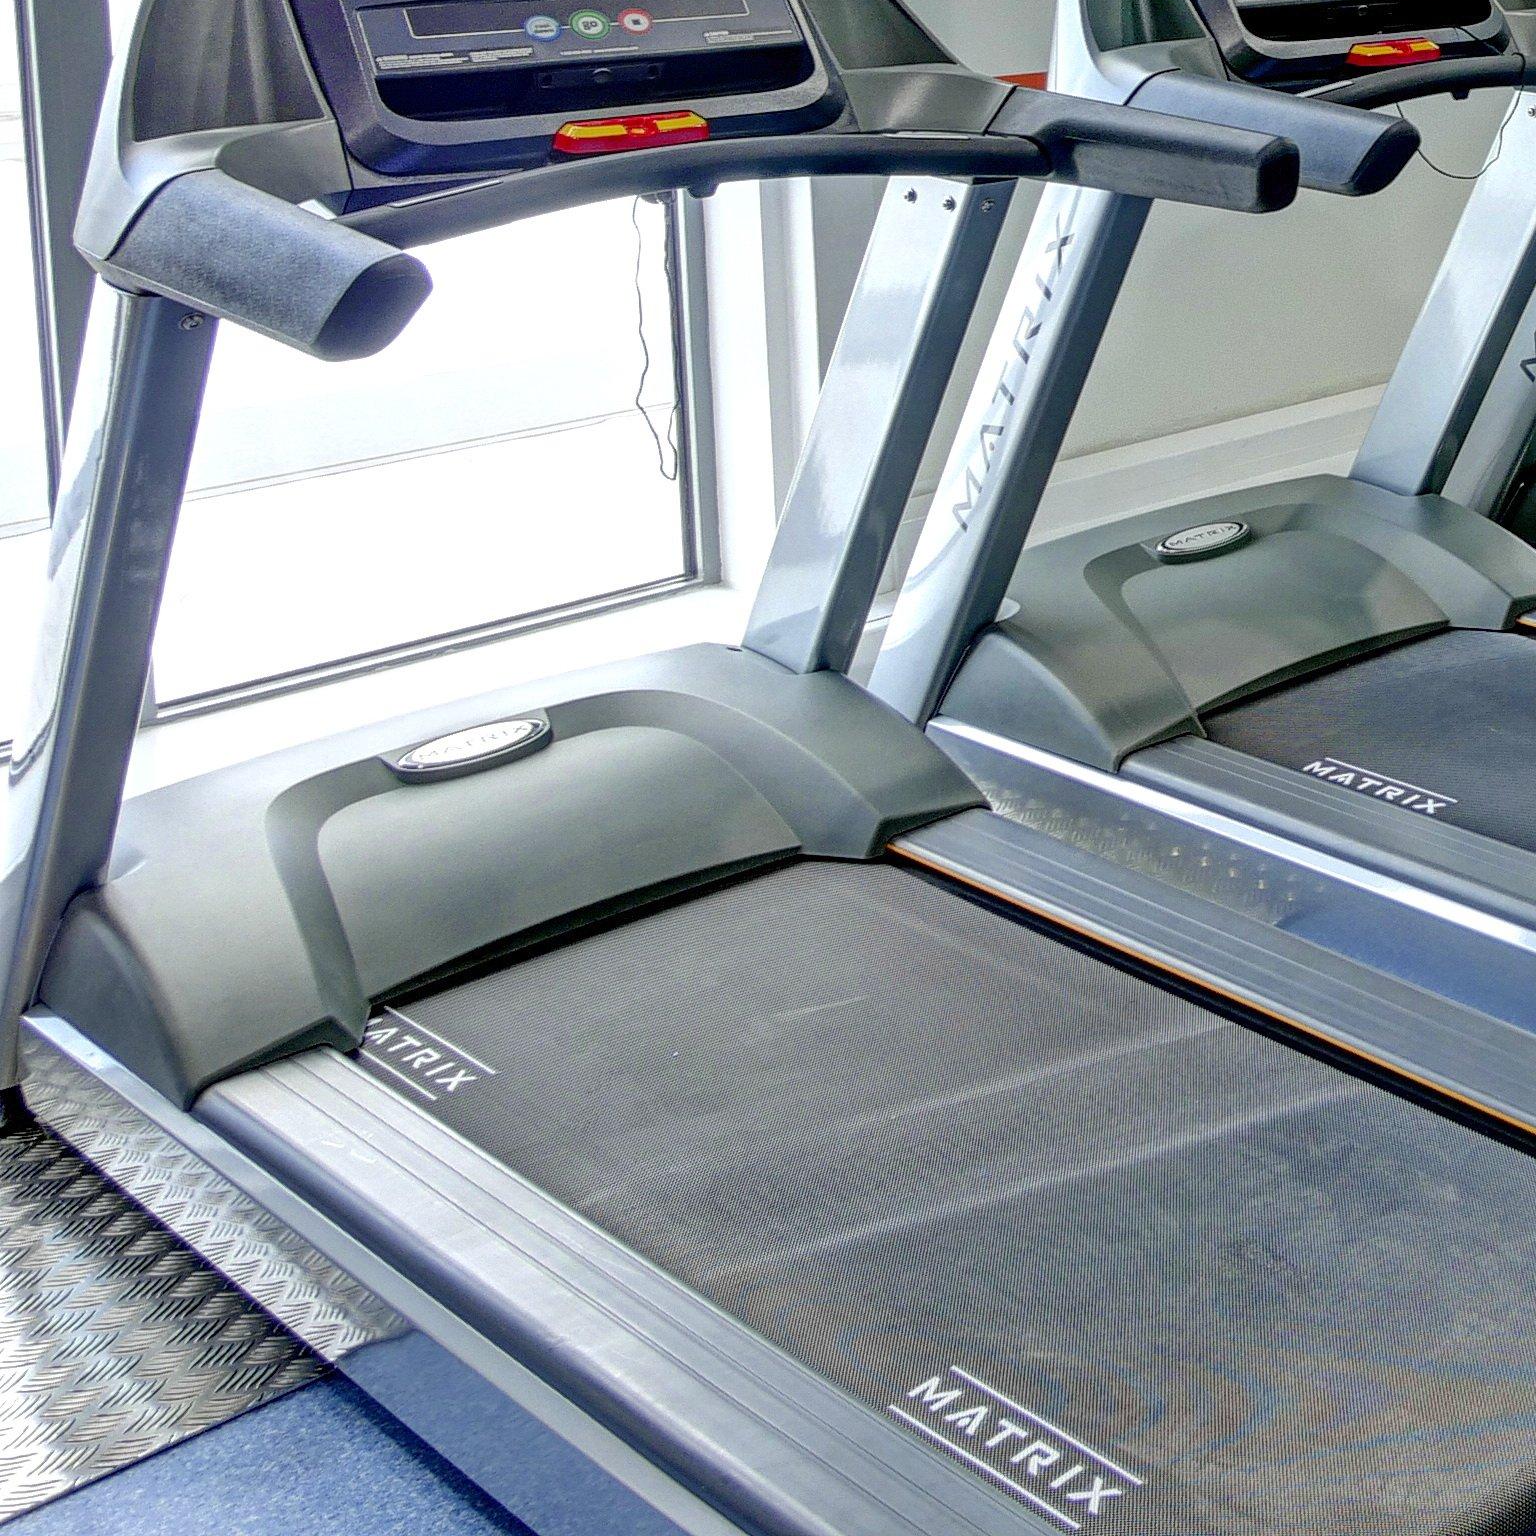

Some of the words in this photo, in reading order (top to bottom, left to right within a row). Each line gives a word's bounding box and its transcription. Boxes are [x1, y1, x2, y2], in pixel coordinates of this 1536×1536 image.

[952, 211, 1076, 533] MATRIX
[1168, 525, 1237, 547] MATRIX
[1301, 759, 1450, 816] MATRIX
[906, 1375, 1123, 1516] MATRIX
